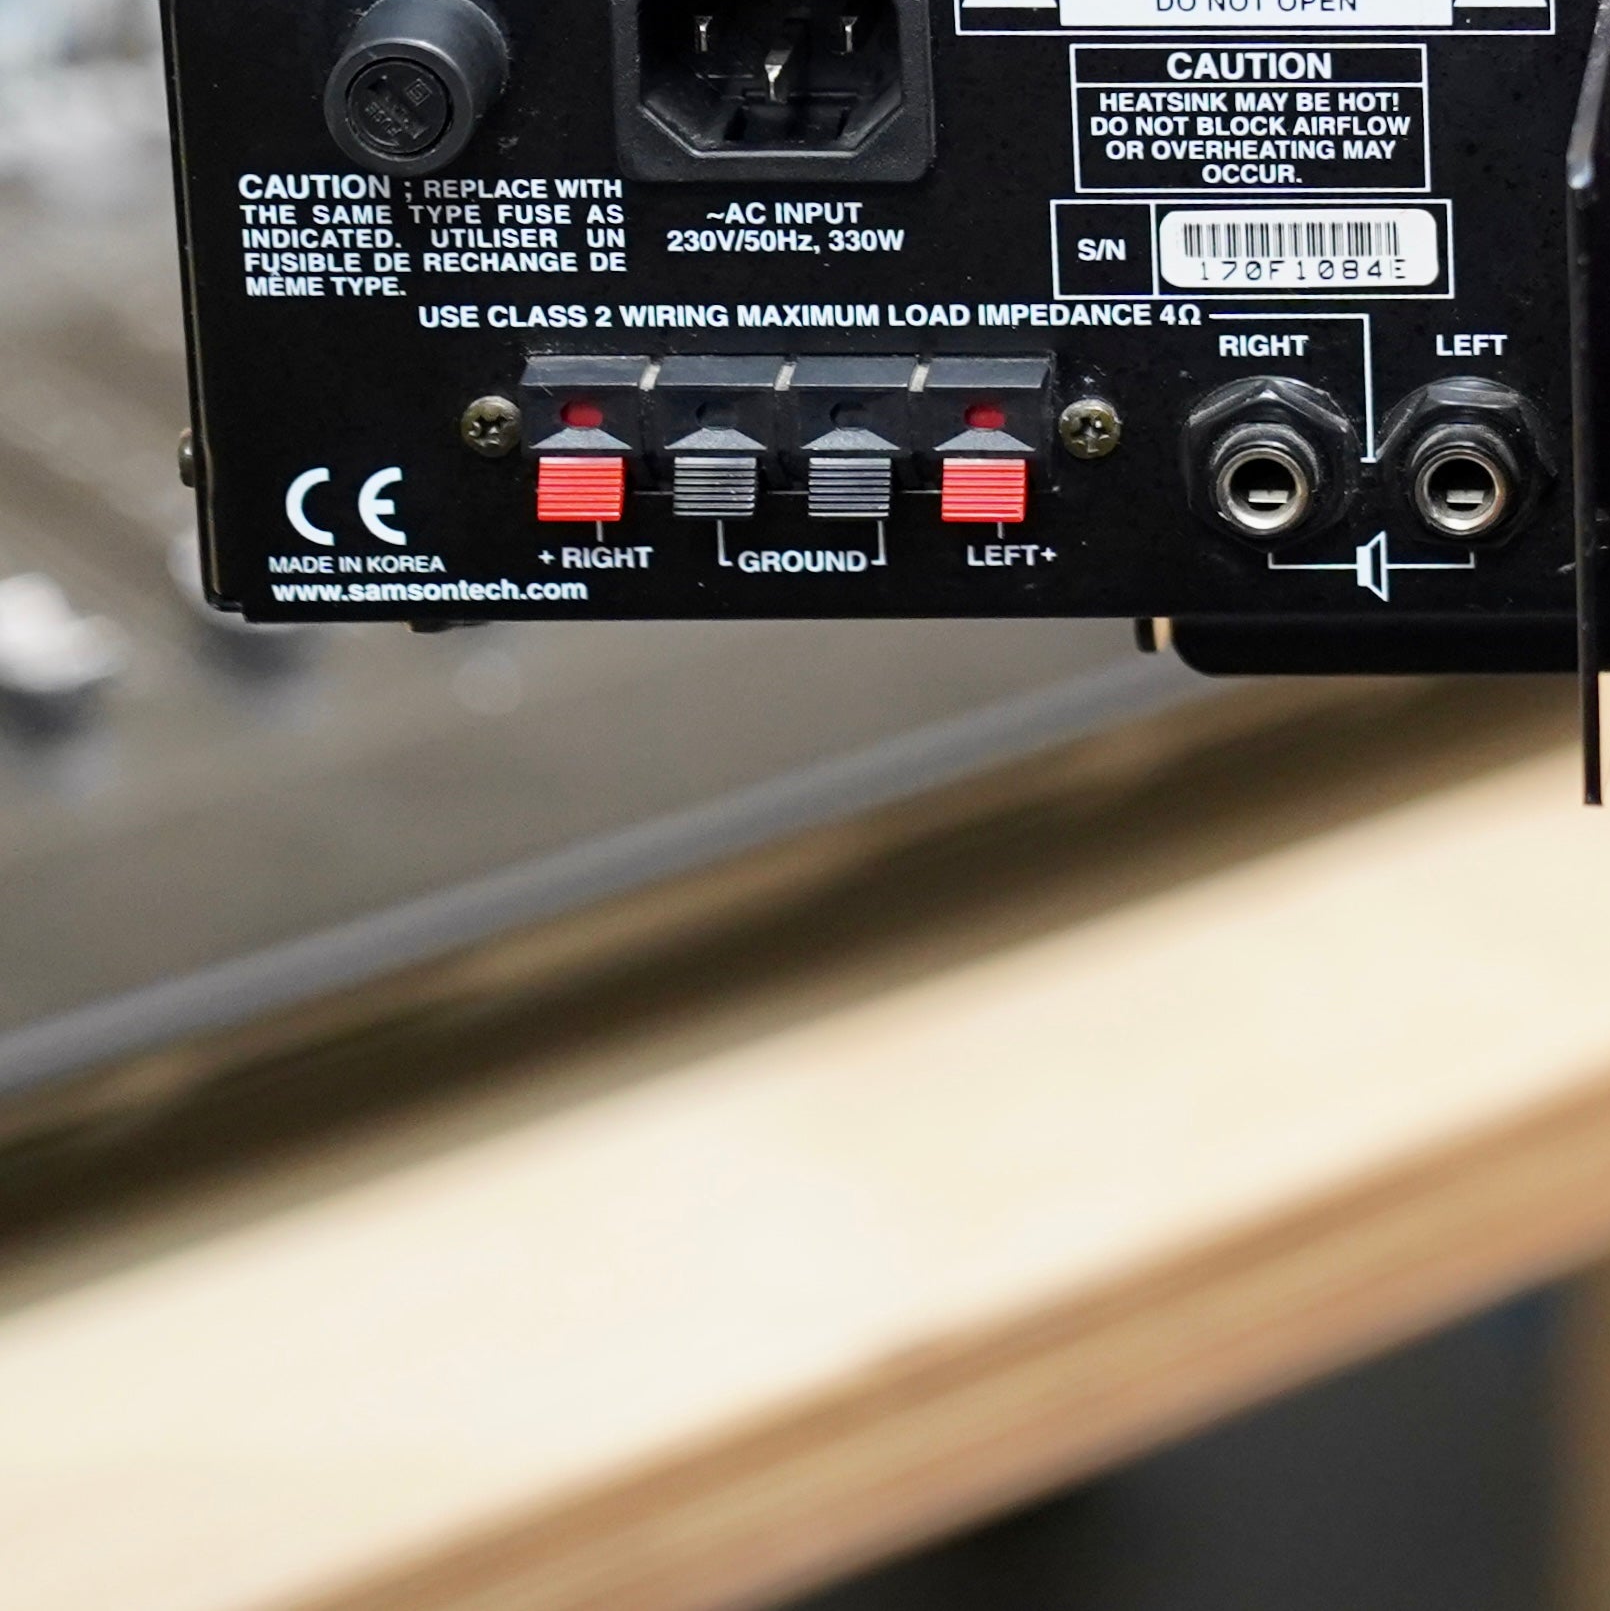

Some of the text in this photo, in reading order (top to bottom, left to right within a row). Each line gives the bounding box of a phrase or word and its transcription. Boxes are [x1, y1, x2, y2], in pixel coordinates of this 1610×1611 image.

[1167, 52, 1332, 80] CAUTION
[1100, 92, 1399, 112] HEATSINK MAY BE HOT!
[1091, 116, 1410, 136] DO NOT BLOCK AIRFLOW
[1106, 140, 1396, 160] OR OVERHEATING MAY
[1202, 164, 1302, 184] OCCUR.
[425, 179, 548, 198] REPLACE
[555, 179, 622, 198] WITH
[240, 204, 624, 224] THE SAME TYPE FUSE AS
[775, 202, 862, 224] INPUT
[242, 228, 625, 248] INDICATED. UTILISER UN
[667, 229, 904, 254] 230V/50Hz, 330W
[1078, 238, 1126, 261] S/N
[244, 252, 627, 274] FUSIBLE DE RECHANGE DE
[246, 270, 406, 296] MÊME TYPE.
[419, 304, 1201, 329] USE CLASS 2 WIRING MAXIMUM LOAD IMPEDANCE 4Ω
[1219, 334, 1309, 357] RIGHT
[1436, 334, 1507, 356] LEFT
[286, 467, 406, 546] CE
[269, 555, 446, 573] MADE IN KOREA
[562, 546, 653, 568] RIGHT
[738, 550, 867, 573] GROUND
[272, 579, 588, 601] www.samsontech.com
